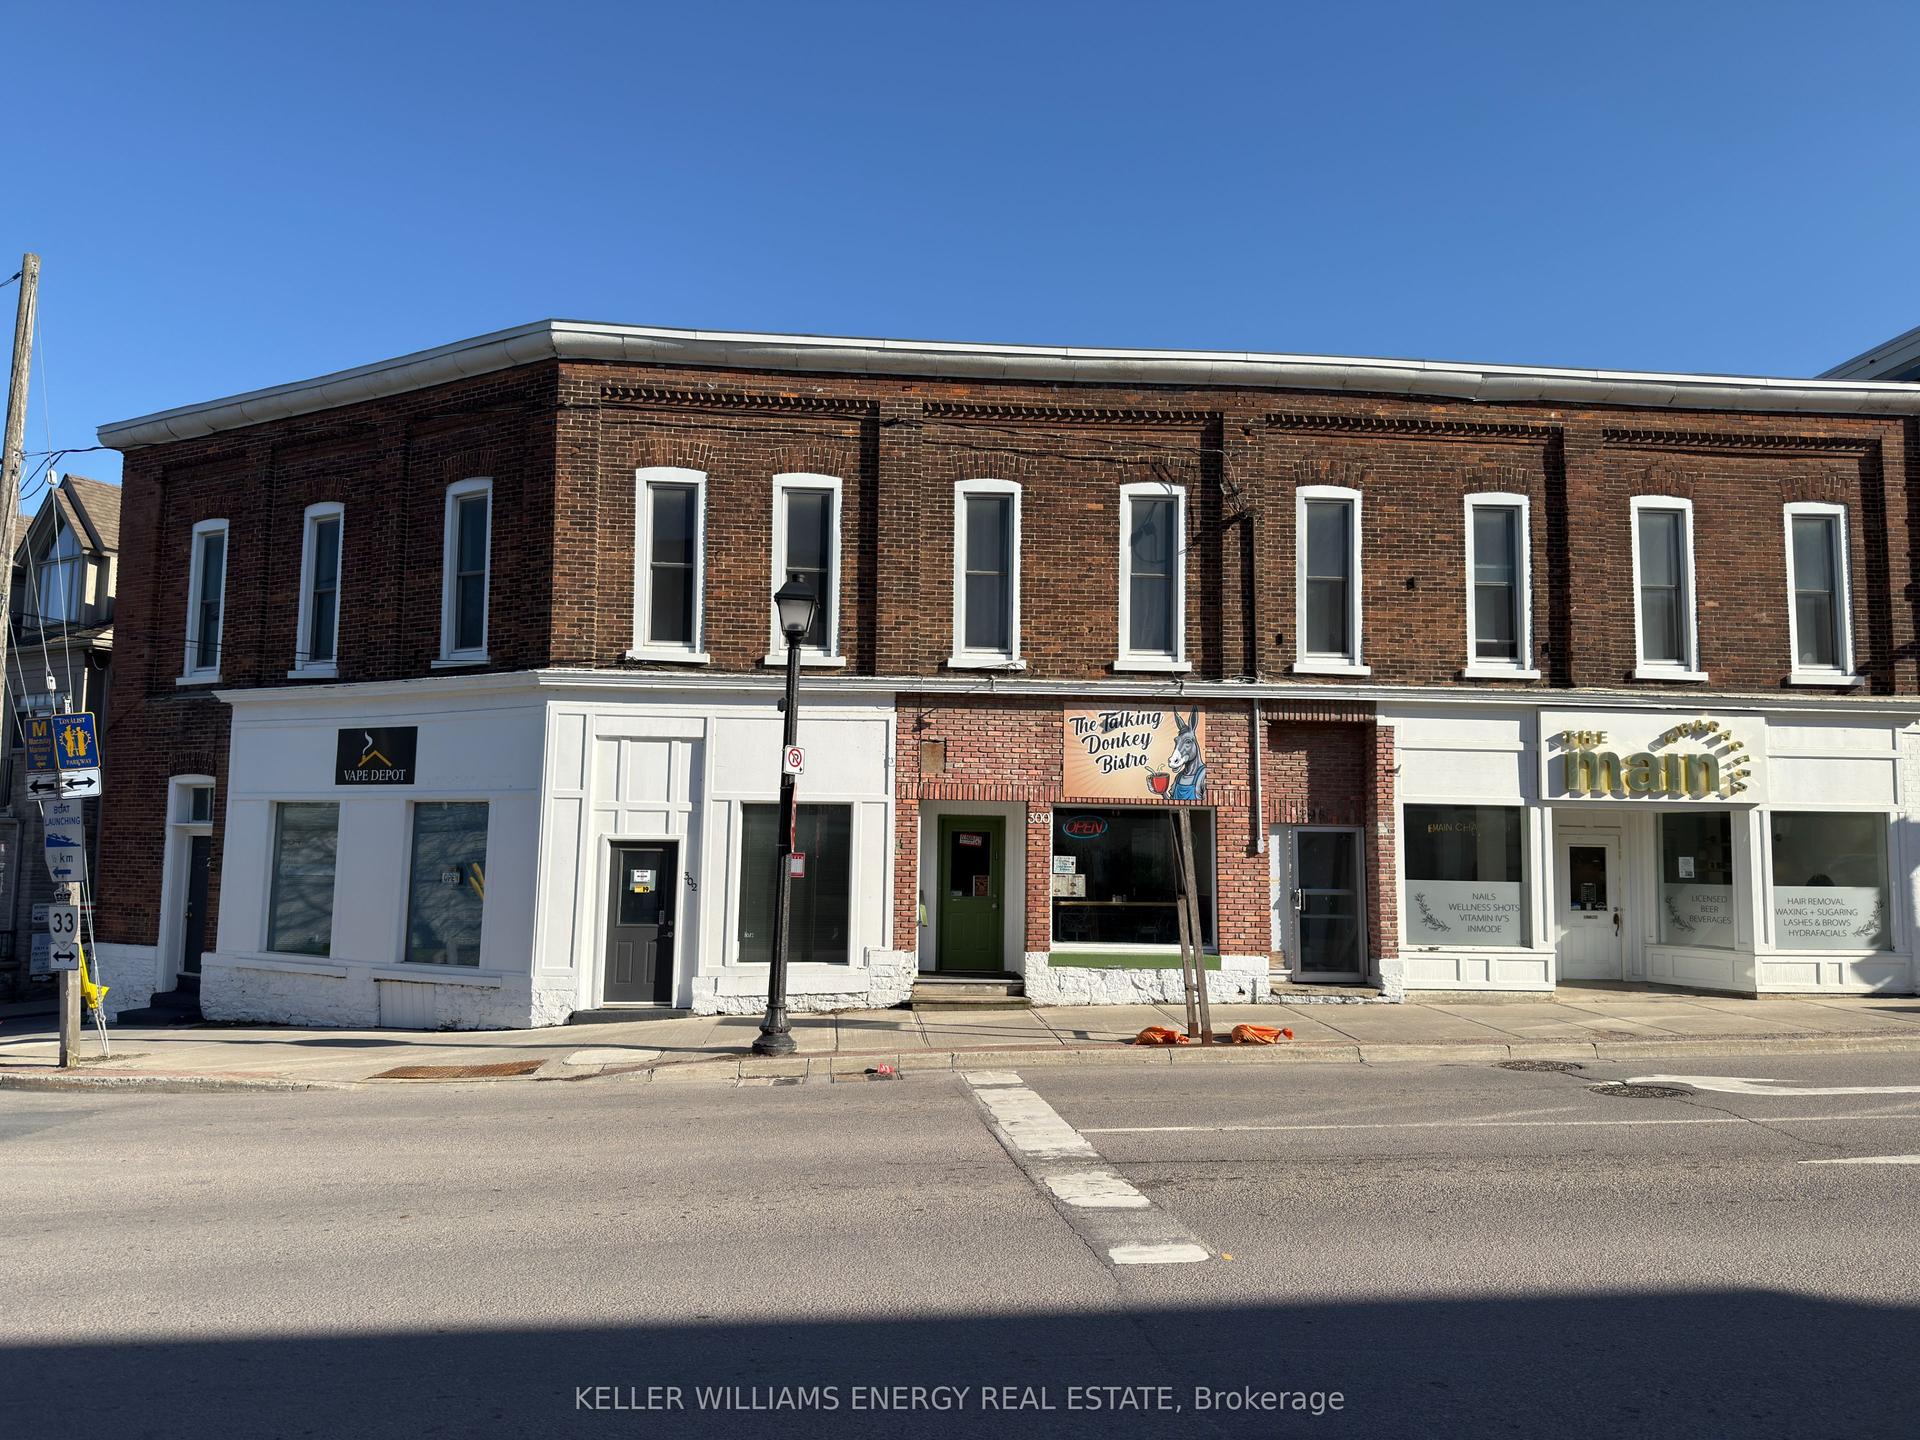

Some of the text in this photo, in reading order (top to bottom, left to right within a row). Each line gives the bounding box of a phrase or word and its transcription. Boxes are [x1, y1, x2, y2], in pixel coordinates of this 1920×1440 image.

[1069, 709, 1162, 736] The Talking
[1081, 732, 1152, 754] Donkey
[1562, 730, 1609, 745] THE
[1096, 753, 1148, 774] Bistro
[344, 769, 406, 781] VAPE DEPOT
[1566, 751, 1720, 792] main
[53, 805, 70, 814] BOAT
[45, 816, 80, 826] LAUNCHING
[1028, 812, 1050, 824] 300
[1066, 821, 1103, 834] OPEN
[60, 853, 74, 863] km
[684, 872, 698, 892] 302
[1691, 895, 1728, 903] LICENSED
[1448, 904, 1521, 912] WELLNESS SHOTS
[1700, 905, 1720, 913] BEER
[1775, 908, 1808, 916] WAXING
[1817, 908, 1858, 916] SUGARING
[53, 913, 74, 933] 33
[1459, 914, 1494, 922] VITAMIN
[1689, 914, 1732, 925] BEVERAGES
[1467, 925, 1503, 933] INMODE
[1788, 929, 1848, 937] HYDRAFACIALS
